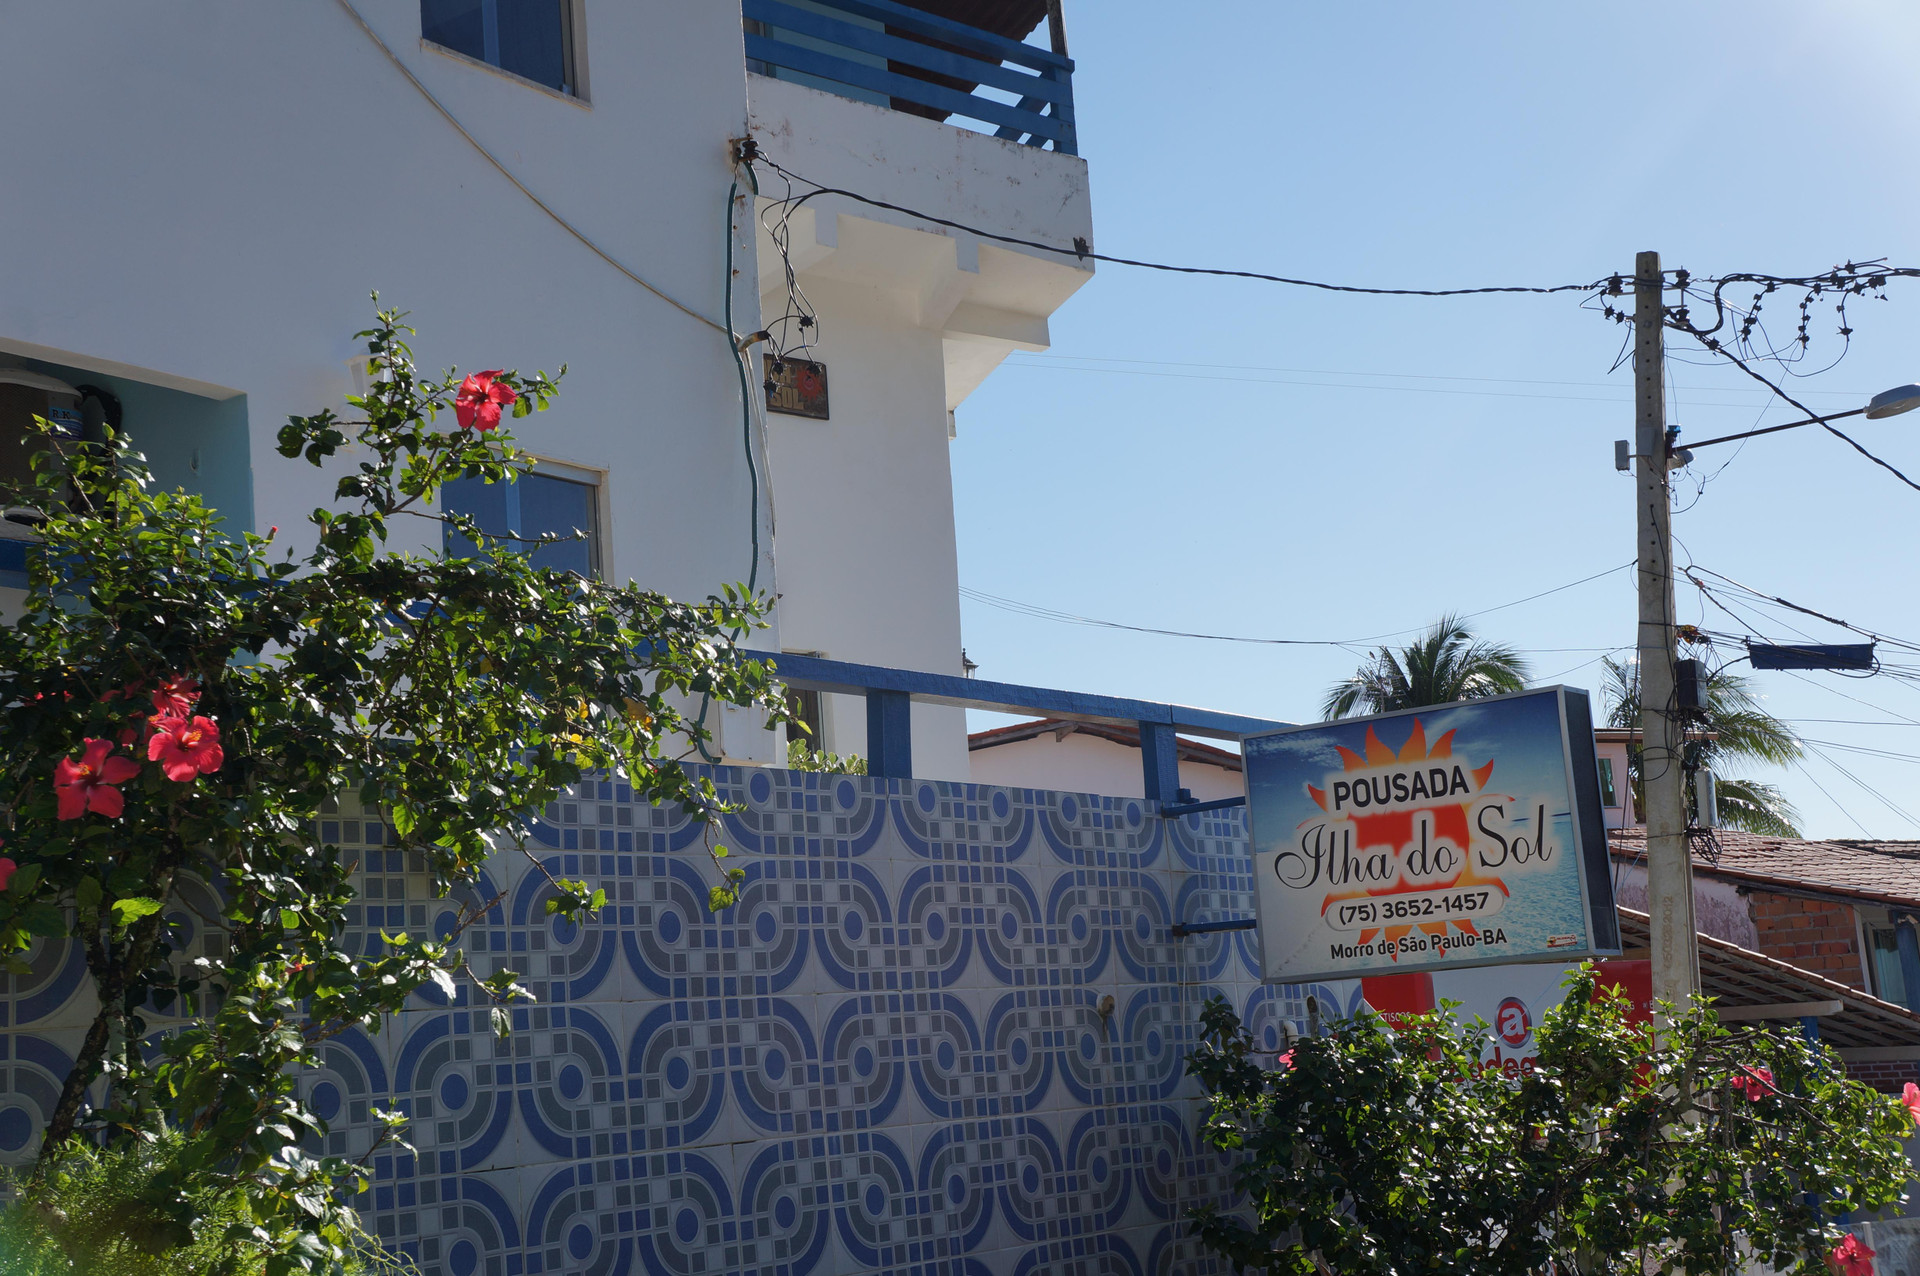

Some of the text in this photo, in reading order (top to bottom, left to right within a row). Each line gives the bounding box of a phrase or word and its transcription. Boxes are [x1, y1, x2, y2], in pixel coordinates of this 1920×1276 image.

[1333, 765, 1470, 811] POUSADA
[1274, 804, 1552, 889] Ilha do Sol
[1339, 892, 1490, 926] (75) 3652-1457
[1330, 928, 1508, 959] Morro de São Paulo-BA
